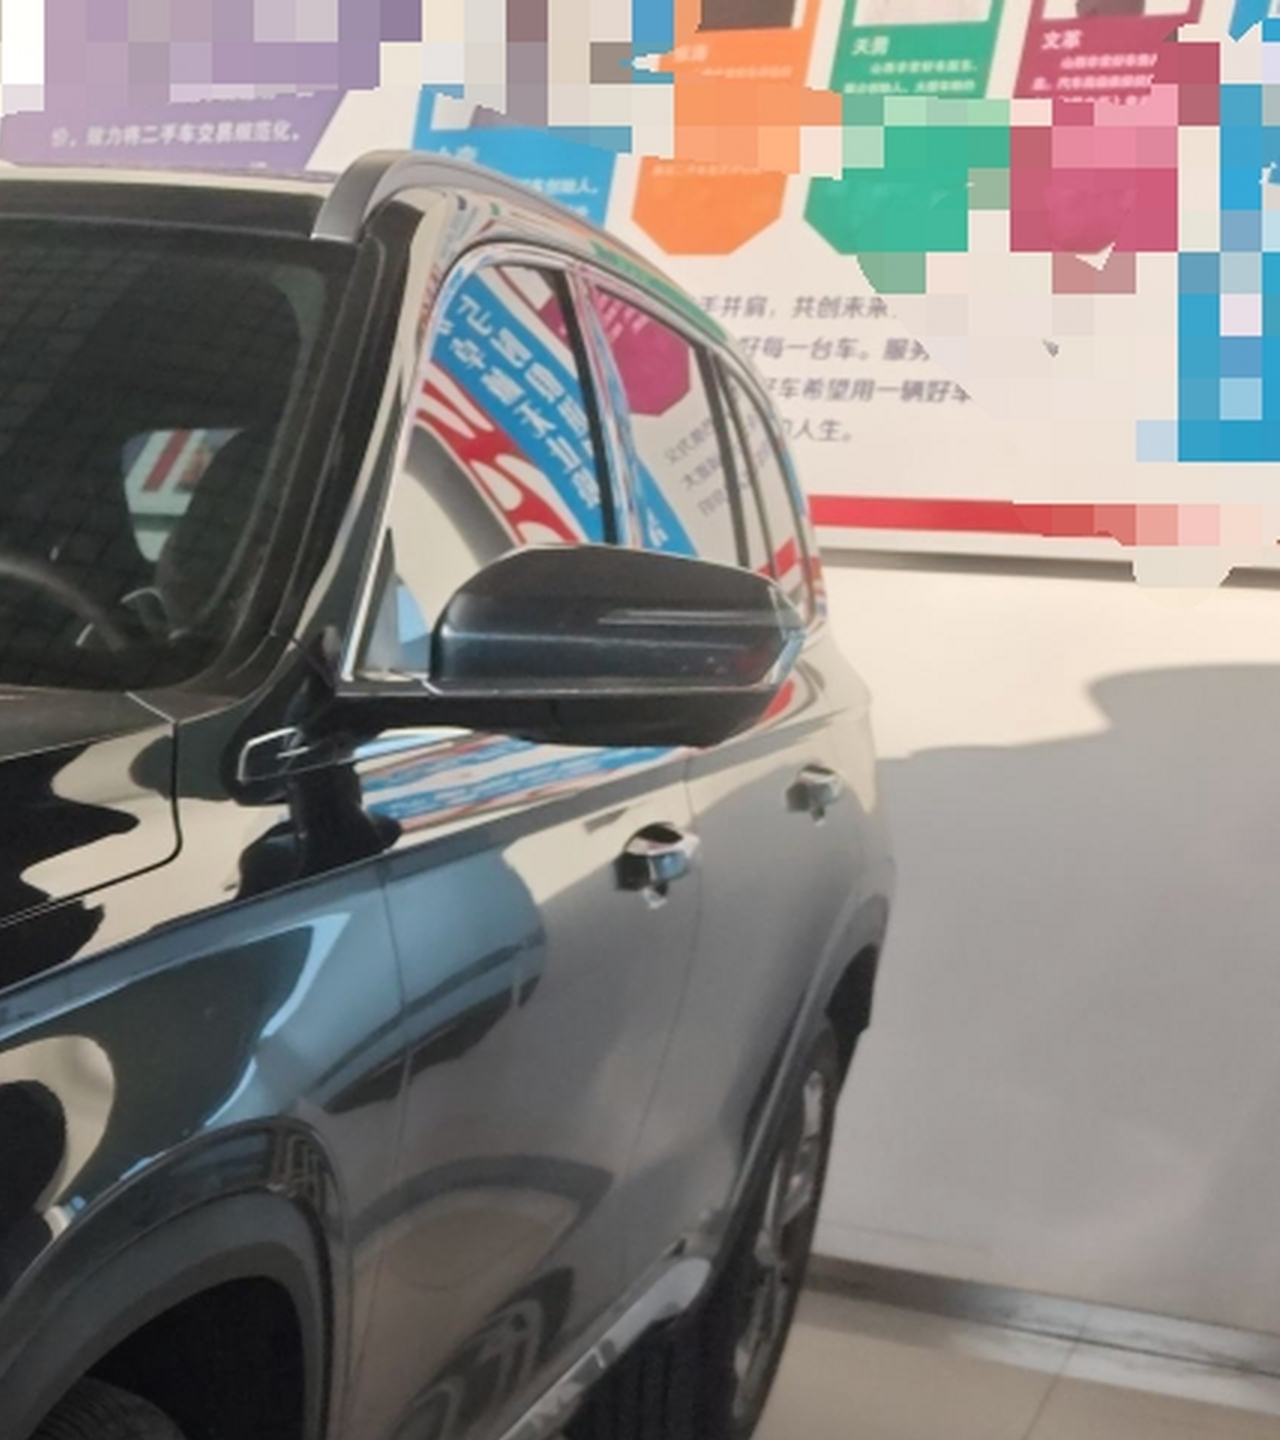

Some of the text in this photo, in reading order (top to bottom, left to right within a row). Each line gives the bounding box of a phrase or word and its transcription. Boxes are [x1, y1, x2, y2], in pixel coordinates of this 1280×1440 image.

[701, 295, 899, 320] 手并肩，共创未来
